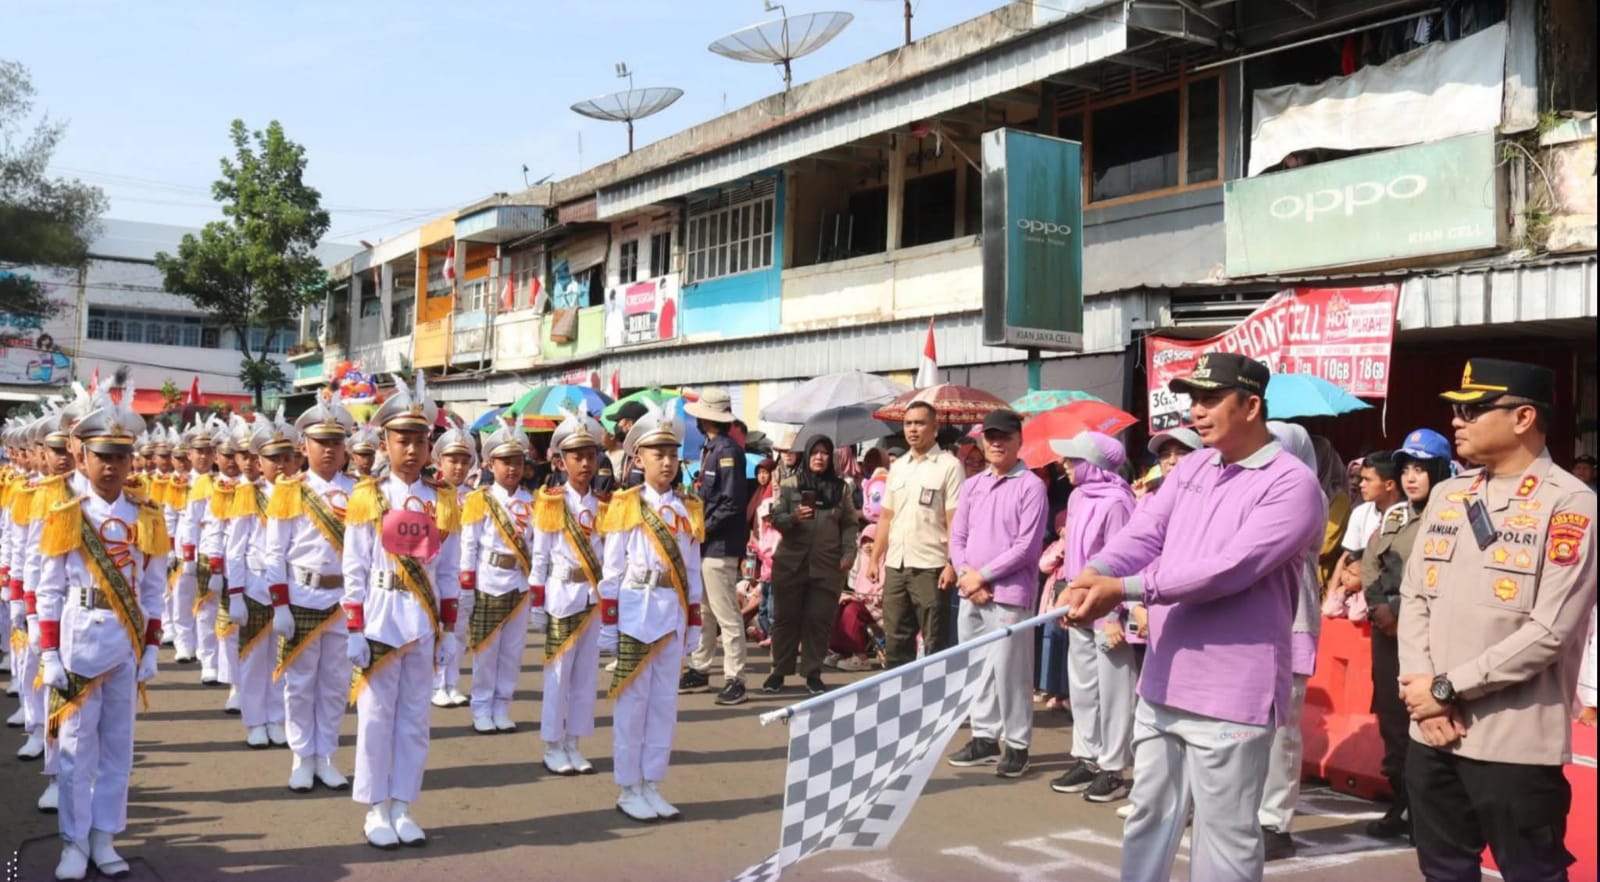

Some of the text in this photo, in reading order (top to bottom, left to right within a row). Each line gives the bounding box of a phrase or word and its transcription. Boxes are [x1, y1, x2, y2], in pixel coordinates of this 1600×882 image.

[1269, 174, 1428, 222] oppo
[1016, 218, 1072, 236] oppo
[1408, 223, 1484, 244] KIAN CELL
[1016, 331, 1072, 345] KIAN JAYA CELL
[1324, 359, 1350, 380] 10GB
[1360, 358, 1385, 380] 18GB
[397, 521, 431, 537] 001
[1427, 523, 1459, 537] JANUAR
[1495, 531, 1538, 546] POLRI
